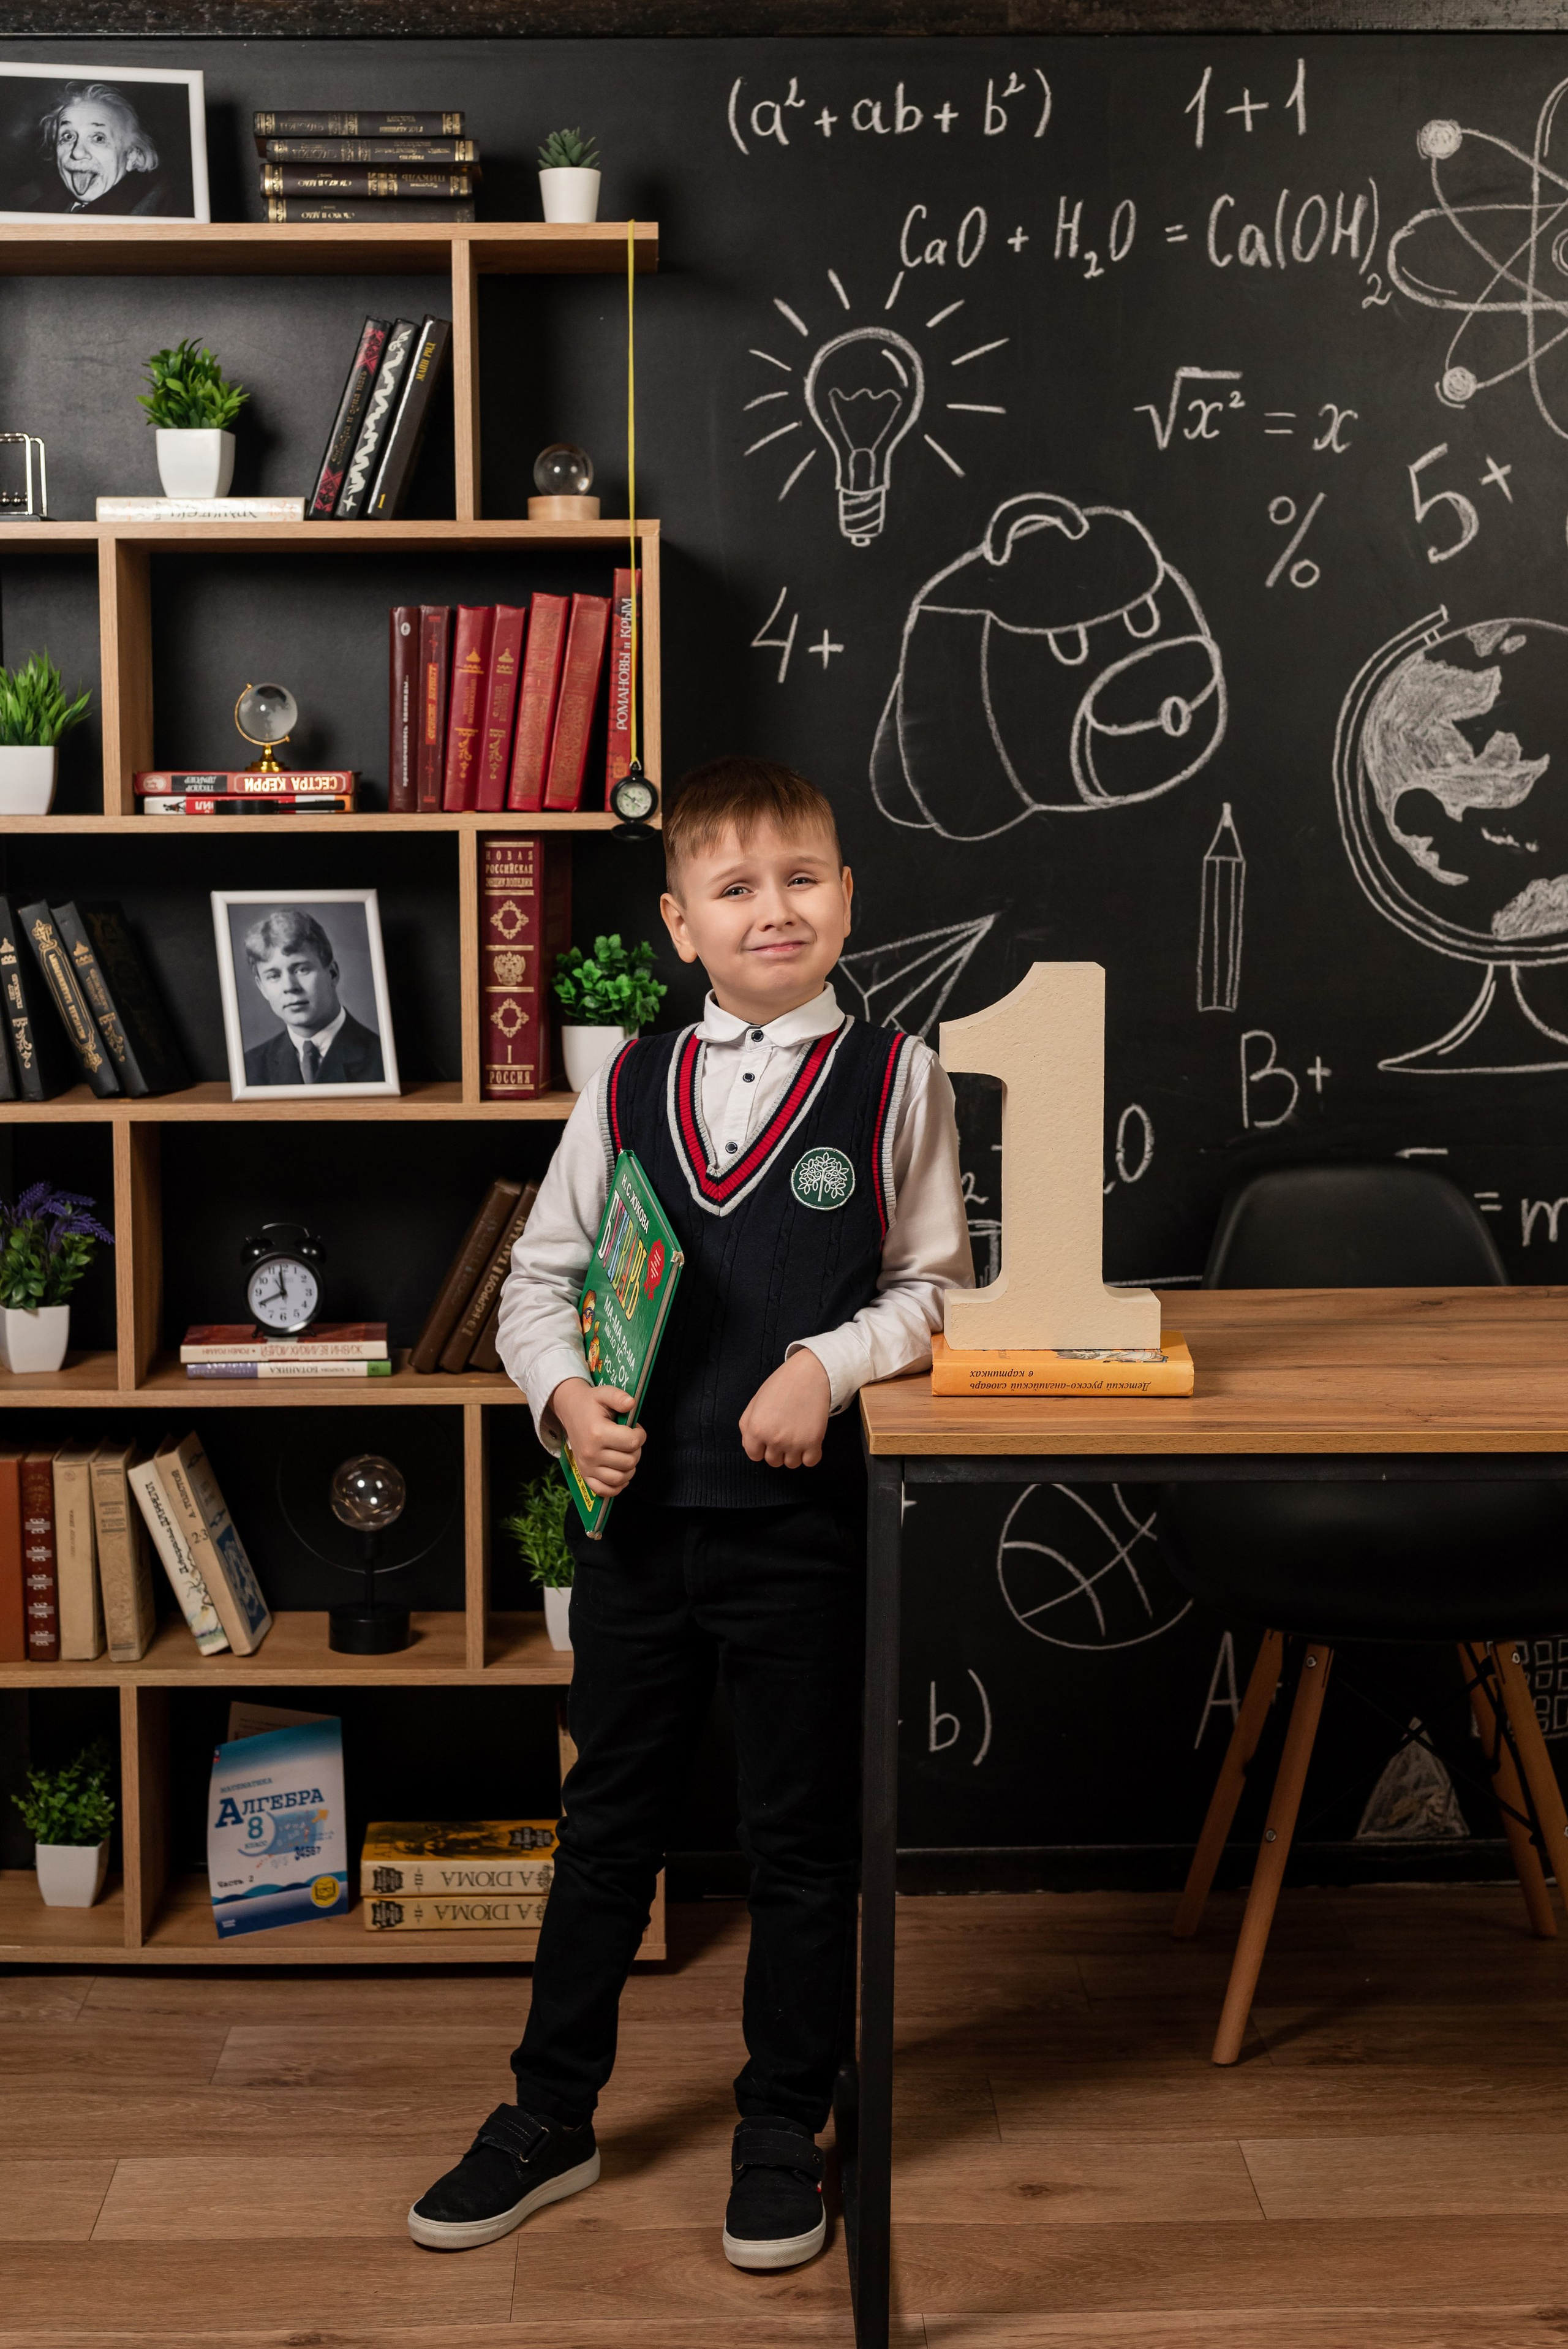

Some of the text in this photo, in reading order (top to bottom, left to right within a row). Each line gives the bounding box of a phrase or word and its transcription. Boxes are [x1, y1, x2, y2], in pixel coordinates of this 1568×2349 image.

[402, 173, 445, 182] ПИКУЛЬ
[415, 342, 436, 382] МАЙН РИД
[619, 597, 633, 639] КРЫМ
[616, 652, 631, 731] РОМАНОВЫ
[244, 776, 338, 792] СЕСТРА КЕРРИ
[194, 800, 214, 813] ЙЛ
[485, 850, 533, 861] НОВАЯ
[485, 862, 533, 874] РОССИЙСКАЯ
[489, 1071, 530, 1084] РОССИЯ
[597, 1189, 647, 1322] БУКВАРЬ
[603, 1295, 636, 1372] МА-МА РА-МА
[260, 1345, 290, 1358] ЛЮДЕЙ
[290, 1345, 328, 1356] ВЕЛИКИХ
[970, 1369, 1025, 1379] картинках
[970, 1380, 1152, 1392] Детский русско-английский словарь
[214, 1788, 325, 1829] АЛГЕБРА
[247, 1815, 263, 1840] 8
[244, 1840, 268, 1849] КЛАСС
[217, 1878, 244, 1889] Часть
